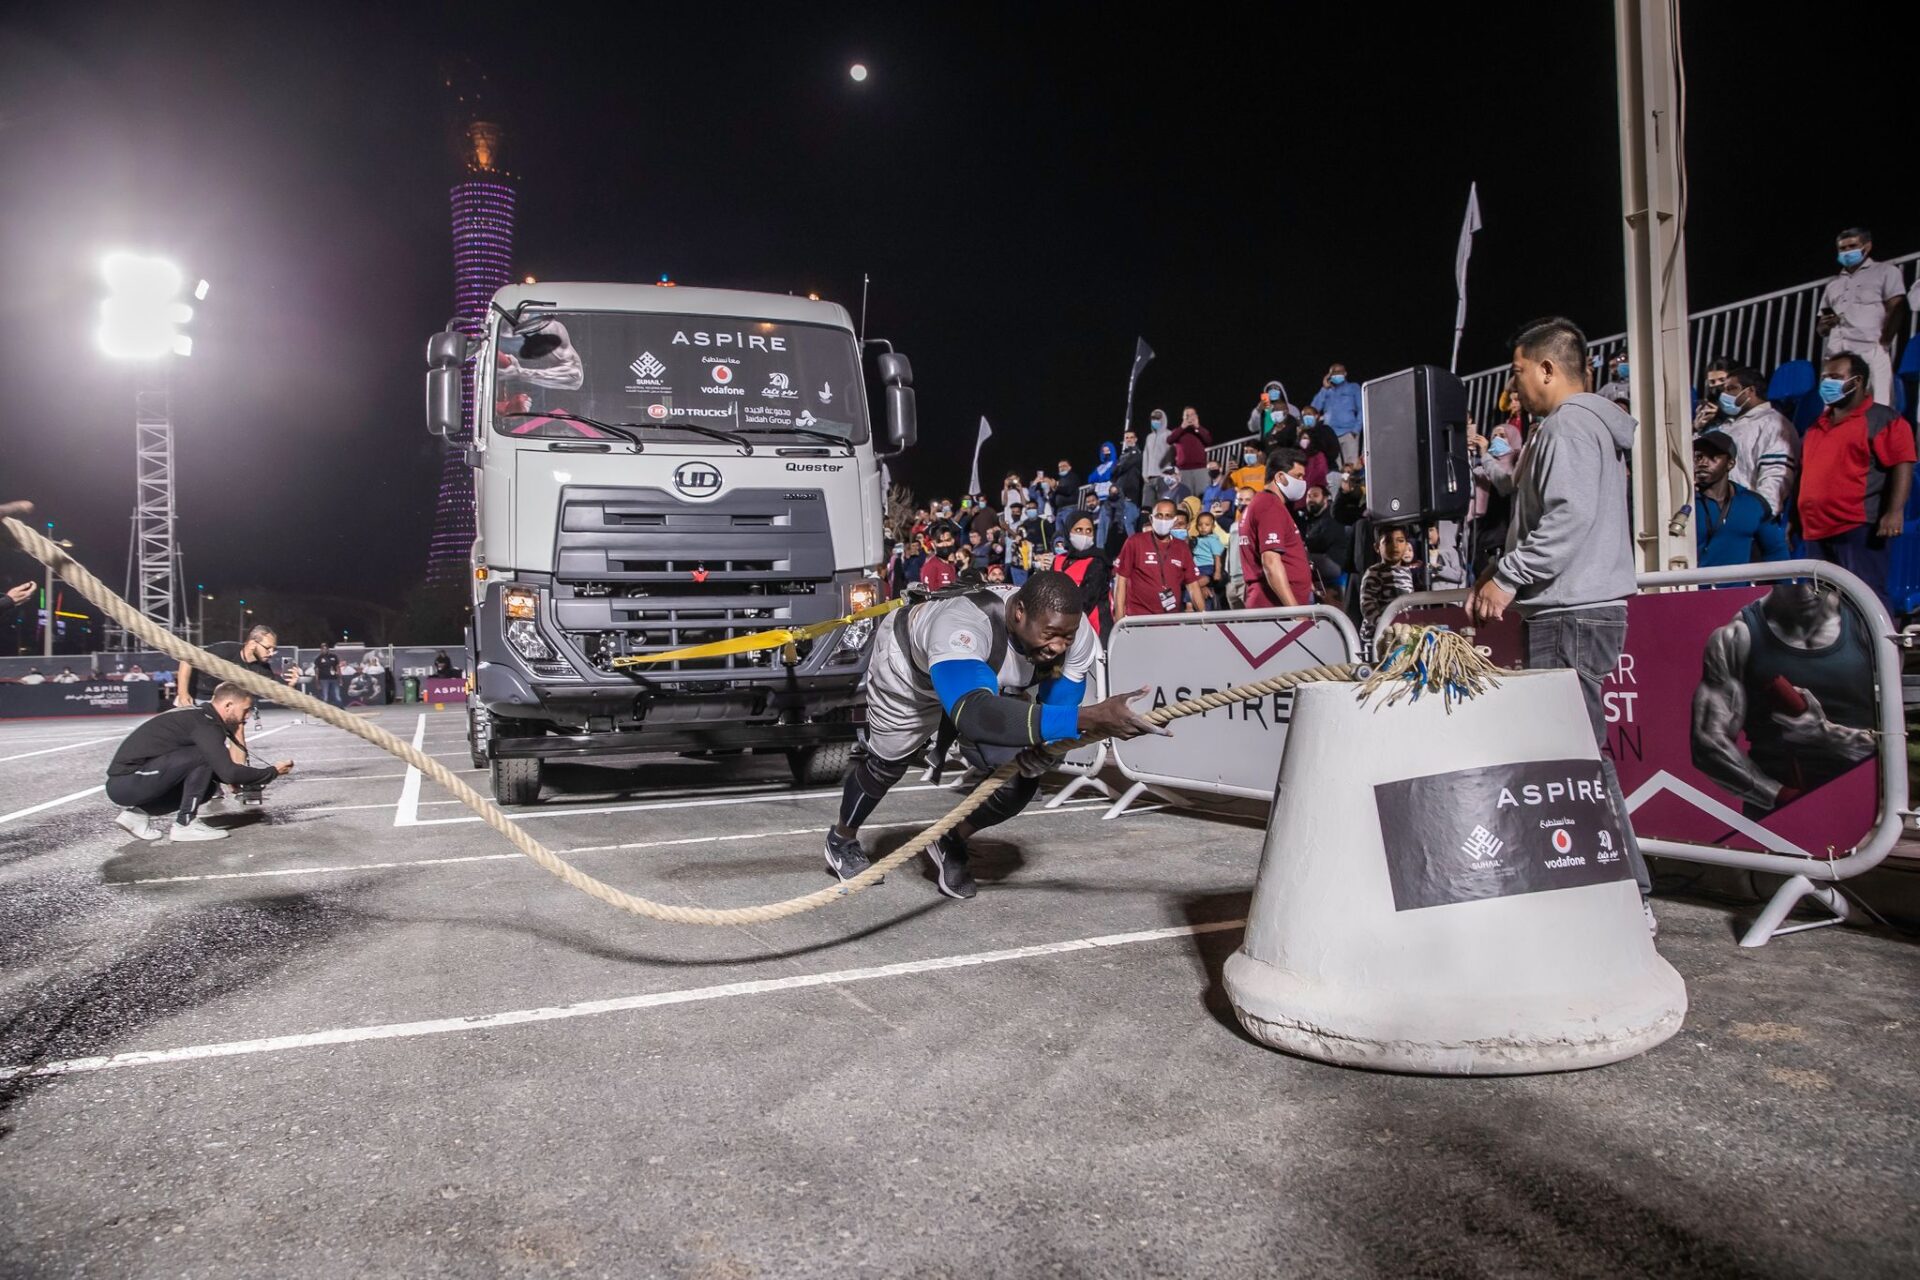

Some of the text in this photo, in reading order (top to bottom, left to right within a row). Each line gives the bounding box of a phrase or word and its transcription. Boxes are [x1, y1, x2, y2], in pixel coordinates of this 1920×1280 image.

[701, 386, 745, 395] vodafone
[670, 408, 728, 417] UD TRUCKS
[769, 416, 792, 425] Group
[786, 463, 844, 472] Quester
[678, 471, 719, 487] UD
[85, 685, 128, 693] ASPIRE
[1544, 856, 1586, 869] vodafone
